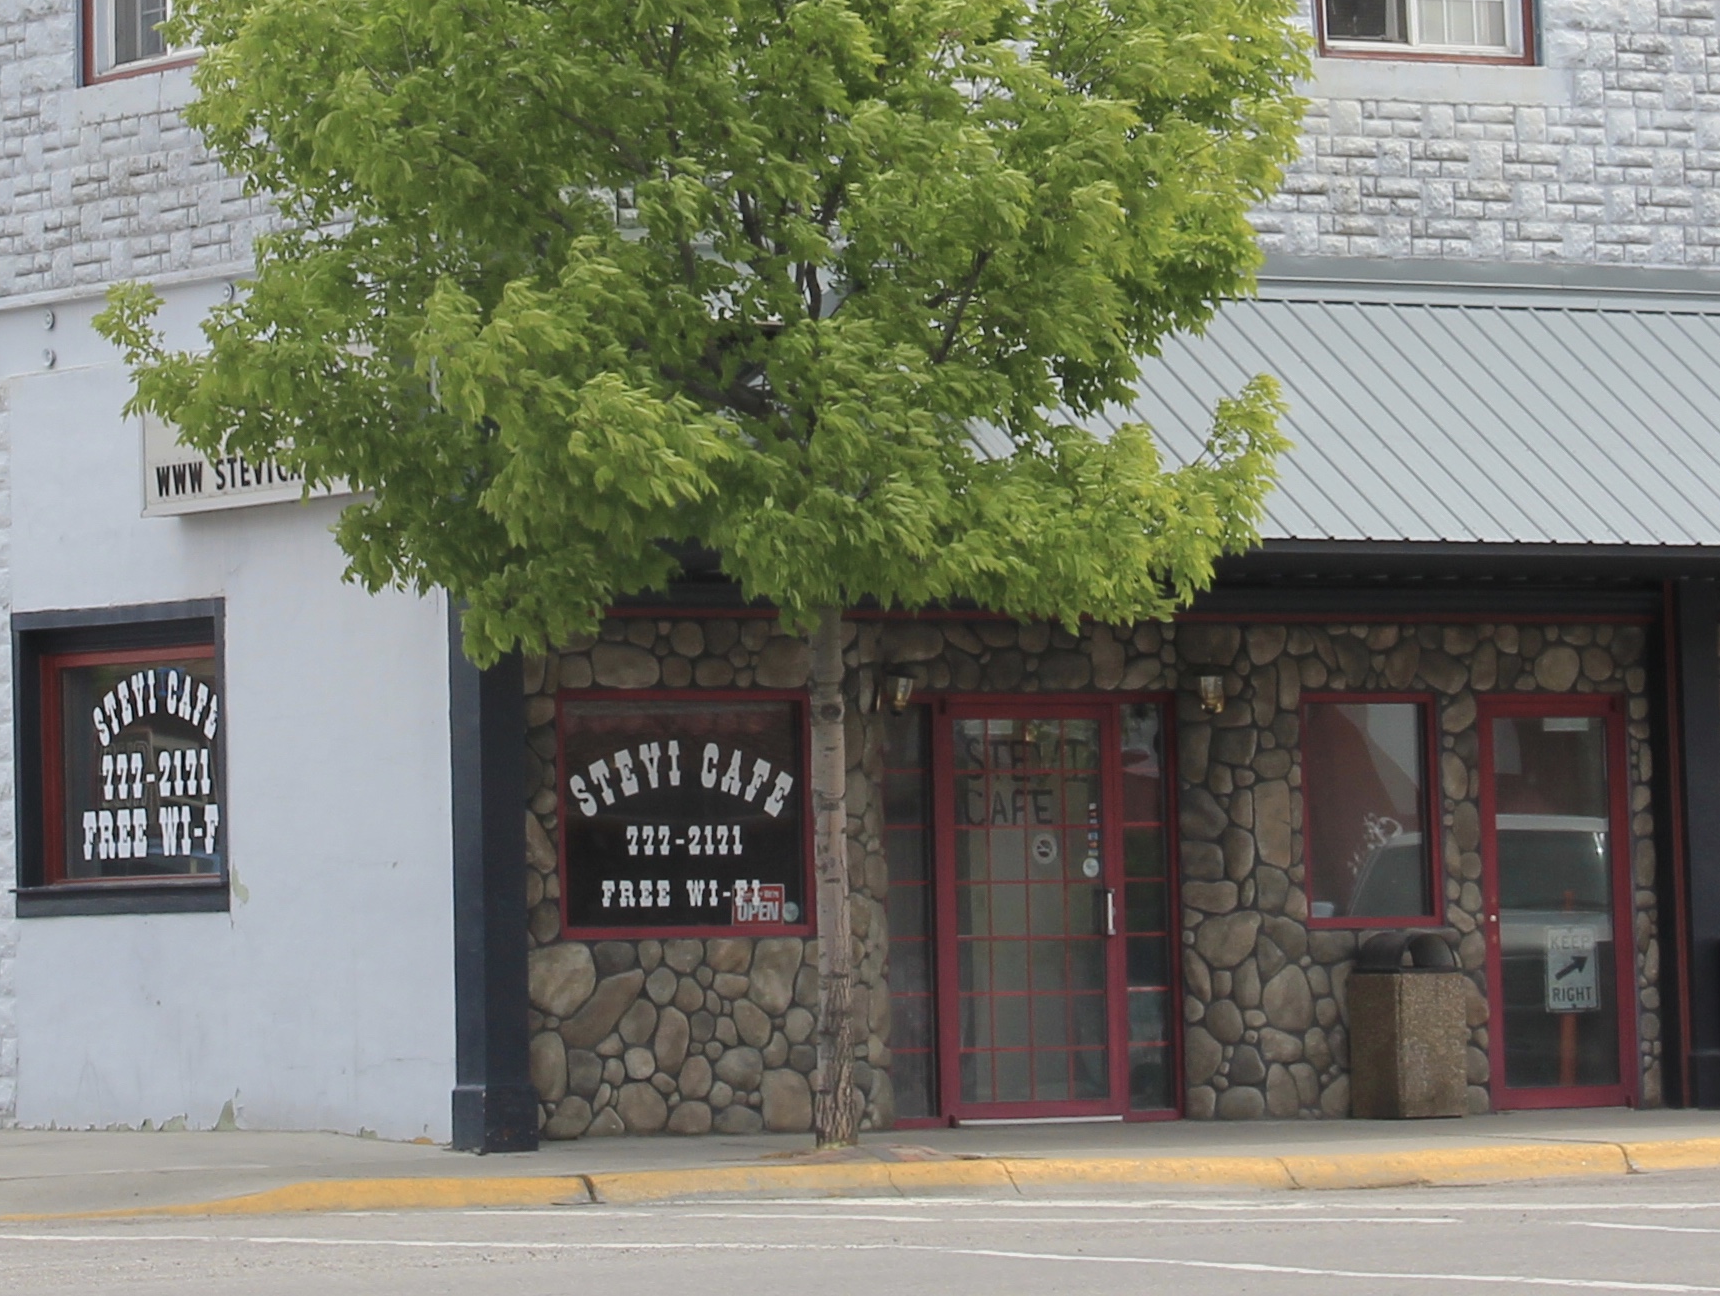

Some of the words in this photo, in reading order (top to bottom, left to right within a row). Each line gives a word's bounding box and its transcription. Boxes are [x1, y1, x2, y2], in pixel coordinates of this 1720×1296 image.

[155, 461, 203, 498] WWW
[93, 669, 156, 747] STEVI
[166, 669, 218, 740] CAFE
[102, 748, 211, 801] 777-2171
[569, 739, 681, 817] STEVI
[701, 742, 794, 818] CAFE
[963, 787, 1054, 827] CAFE
[82, 807, 148, 861] FREE
[626, 824, 743, 856] 777-2171
[601, 880, 671, 907] FREE
[686, 879, 761, 907] WI-FI
[737, 901, 780, 922] OPEN
[1551, 935, 1591, 950] KEEP
[1552, 986, 1592, 1002] RIGHT
